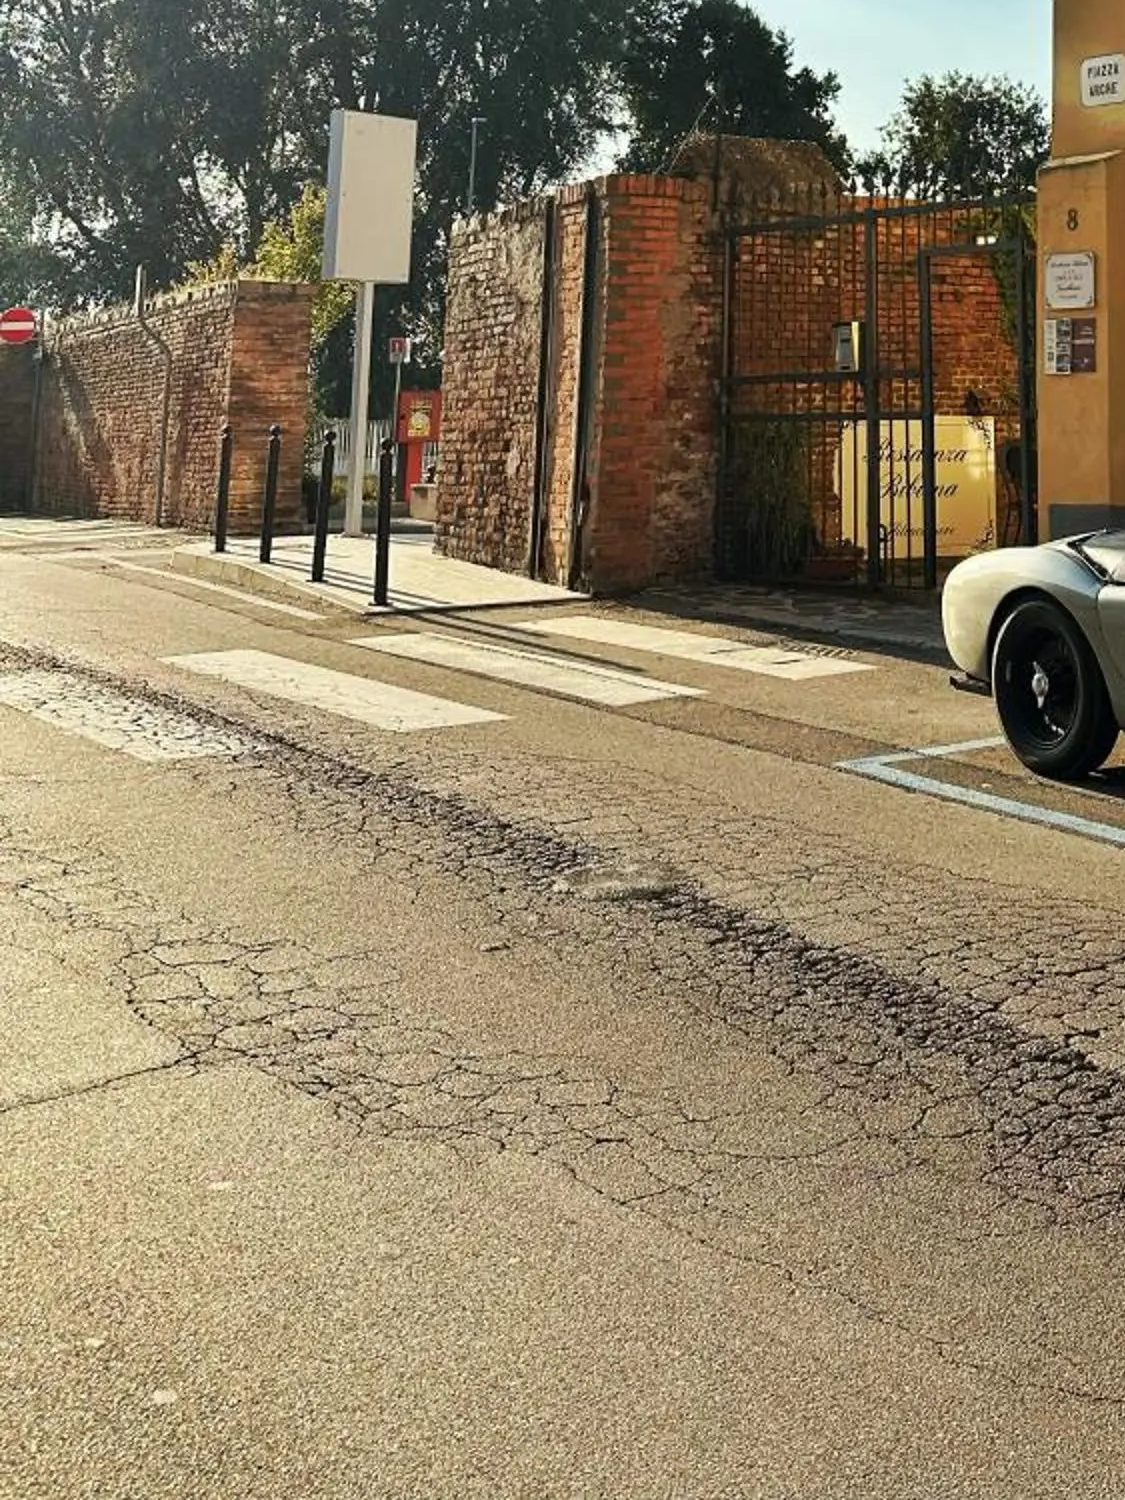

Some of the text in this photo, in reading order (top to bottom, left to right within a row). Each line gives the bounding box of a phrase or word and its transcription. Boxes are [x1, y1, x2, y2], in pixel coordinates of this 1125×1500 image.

[1087, 62, 1120, 79] PIAZZA
[1066, 208, 1079, 231] 8
[863, 437, 967, 463] Resdnza
[882, 473, 959, 499] Bibna
